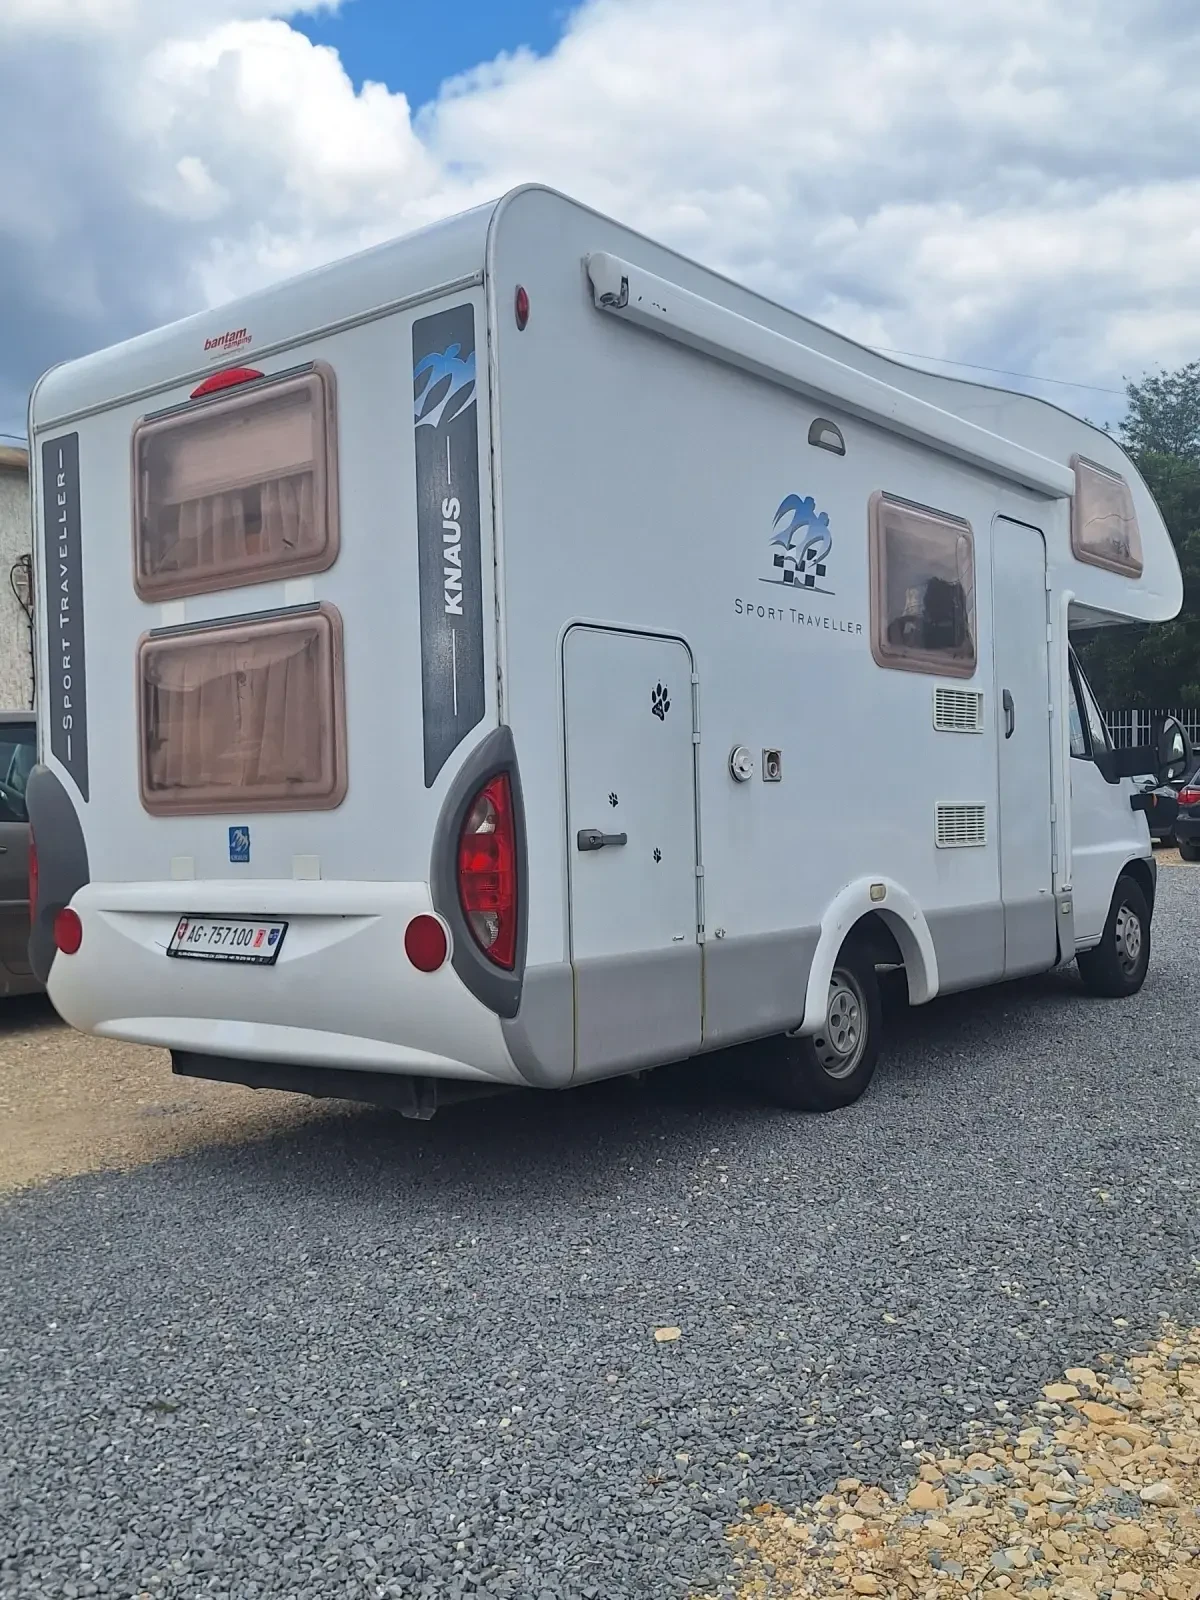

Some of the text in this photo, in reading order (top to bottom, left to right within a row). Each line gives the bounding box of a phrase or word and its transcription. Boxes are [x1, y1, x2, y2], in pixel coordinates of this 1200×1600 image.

[204, 328, 246, 350] bantam
[223, 335, 252, 349] camping
[441, 497, 462, 615] KNAUS
[57, 472, 73, 729] SPORT TRAVELLER
